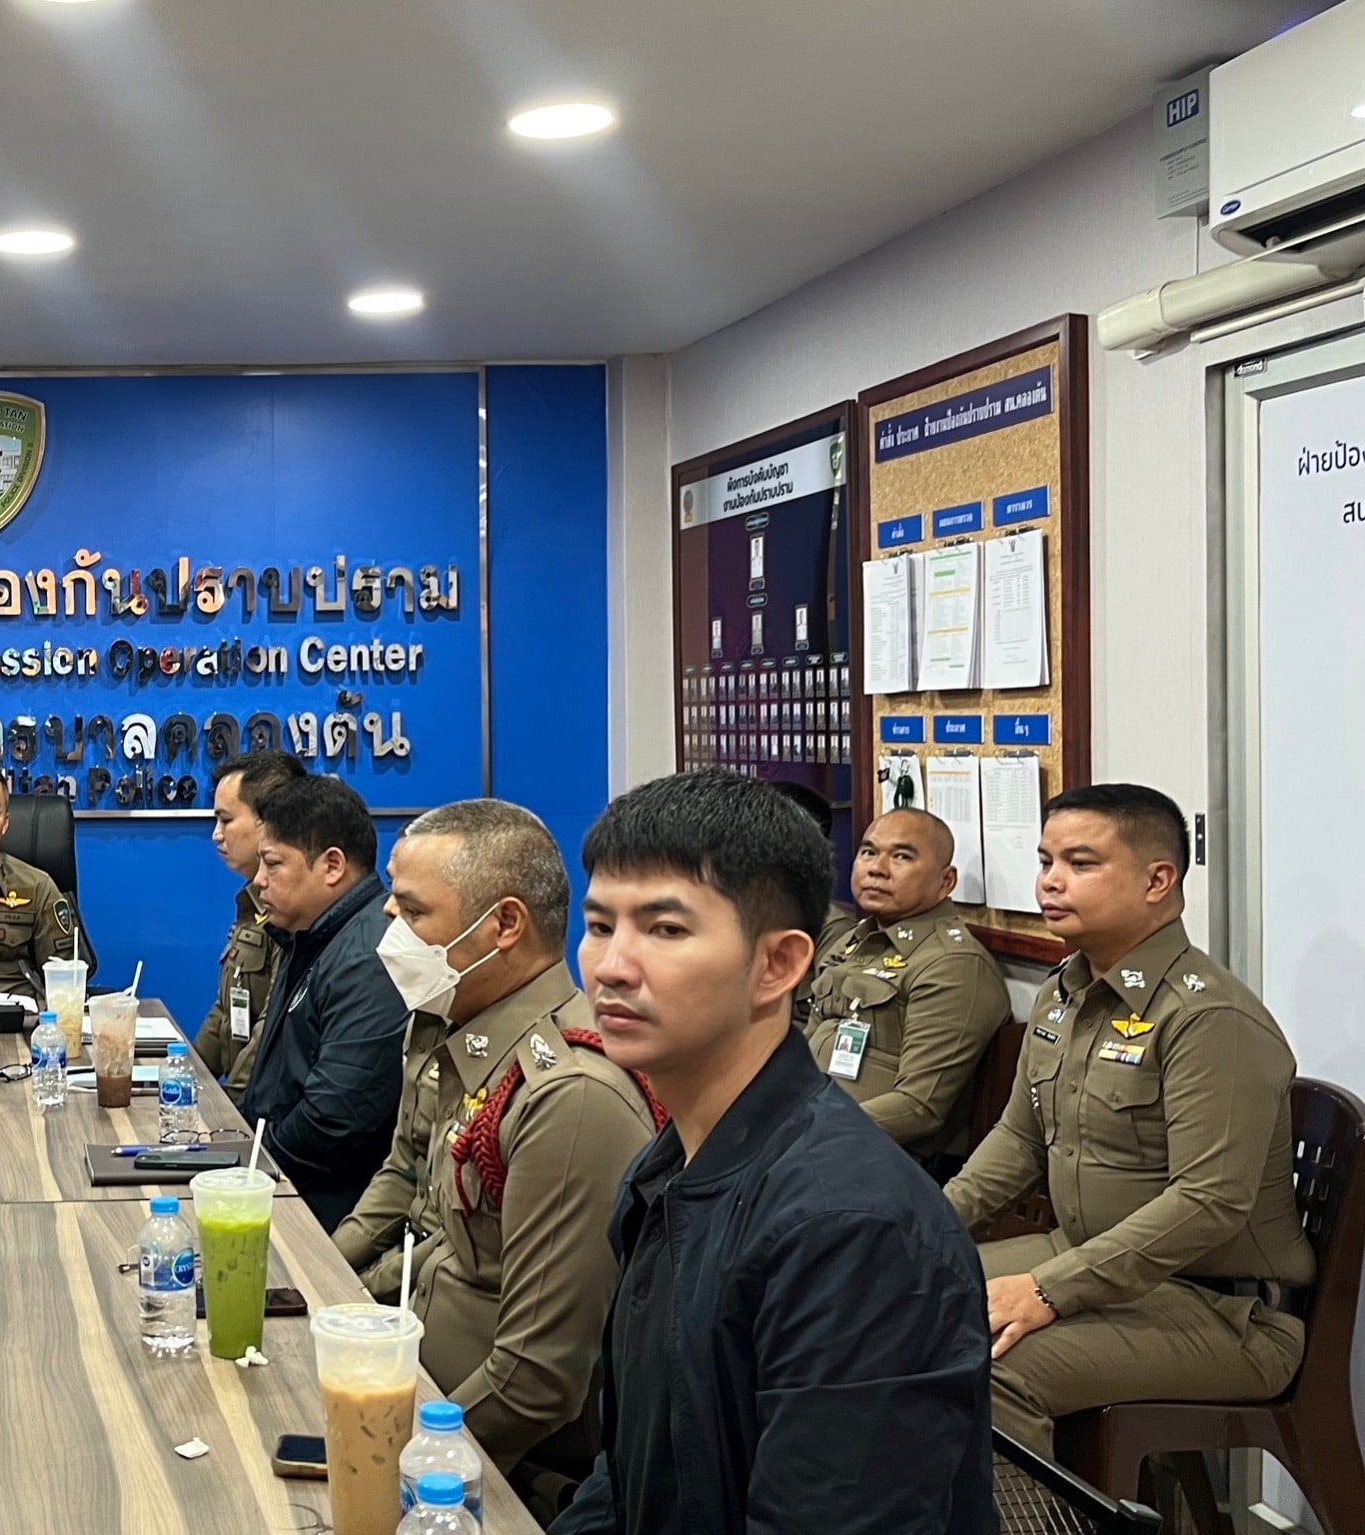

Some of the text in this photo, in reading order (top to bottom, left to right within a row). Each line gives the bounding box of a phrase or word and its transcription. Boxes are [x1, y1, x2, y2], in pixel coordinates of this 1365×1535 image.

[1168, 92, 1198, 125] HIP
[5, 406, 28, 421] TAN
[1298, 440, 1365, 477] ฝ่ายป้อ
[109, 636, 288, 686] Operation
[299, 636, 424, 674] Center
[89, 765, 198, 803] Police
